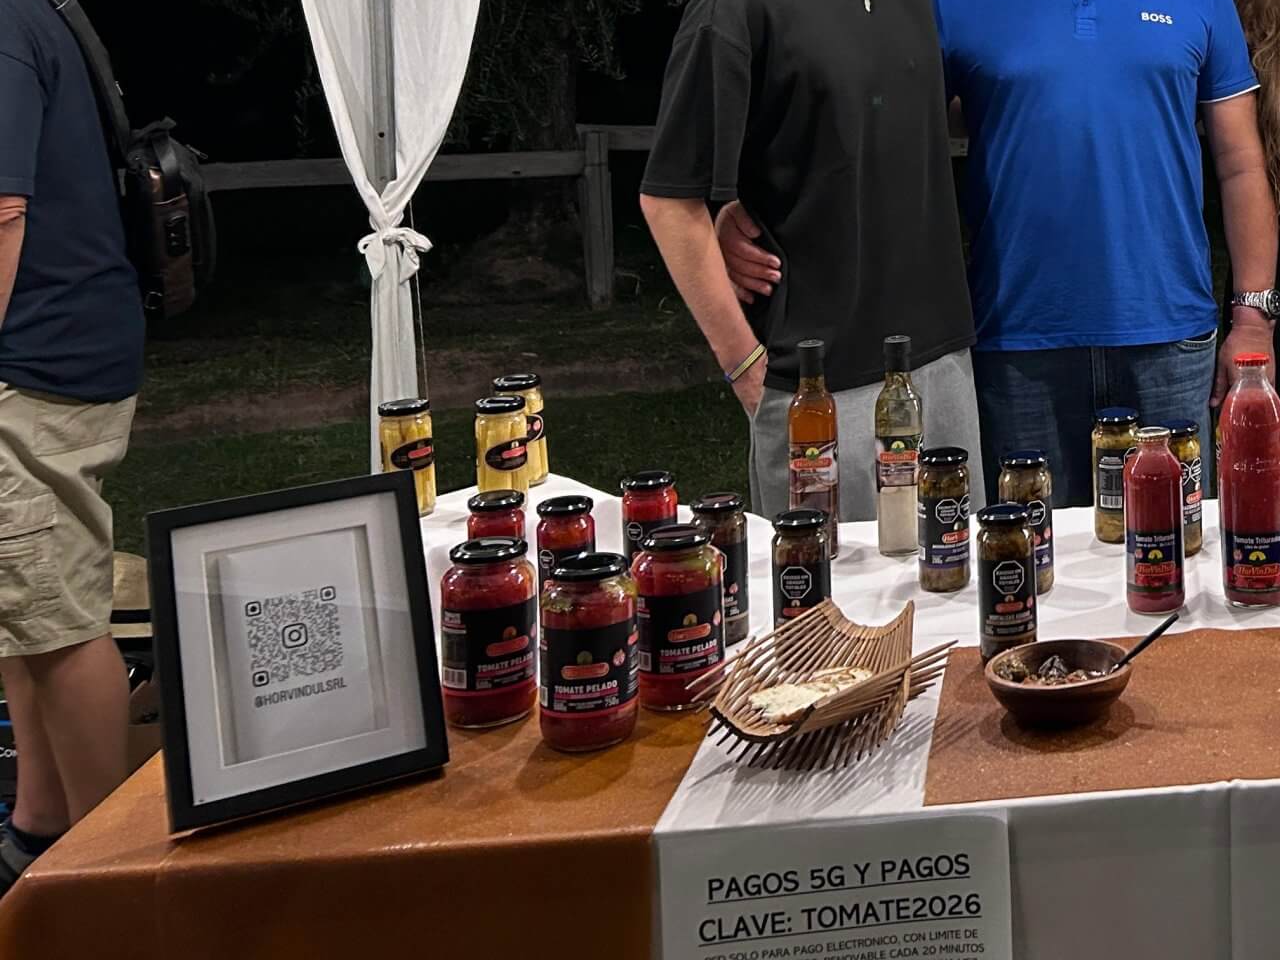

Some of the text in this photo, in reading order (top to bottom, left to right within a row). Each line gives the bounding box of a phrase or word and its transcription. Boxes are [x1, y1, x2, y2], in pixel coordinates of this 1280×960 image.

[1140, 11, 1174, 26] BOSS
[254, 676, 348, 709] @HORVINDULSRL
[586, 679, 618, 693] PELADO
[707, 853, 971, 901] PAGOS 5G Y PAGOS
[698, 893, 982, 943] CLAVE: TOMATE2026
[761, 947, 790, 959] PARA
[793, 943, 824, 956] PAGO
[903, 933, 926, 944] CON
[929, 929, 961, 941] LIMITE
[964, 928, 979, 939] DE
[889, 947, 919, 959] CADA
[922, 945, 937, 956] 20
[939, 943, 985, 955] MINUTOS
